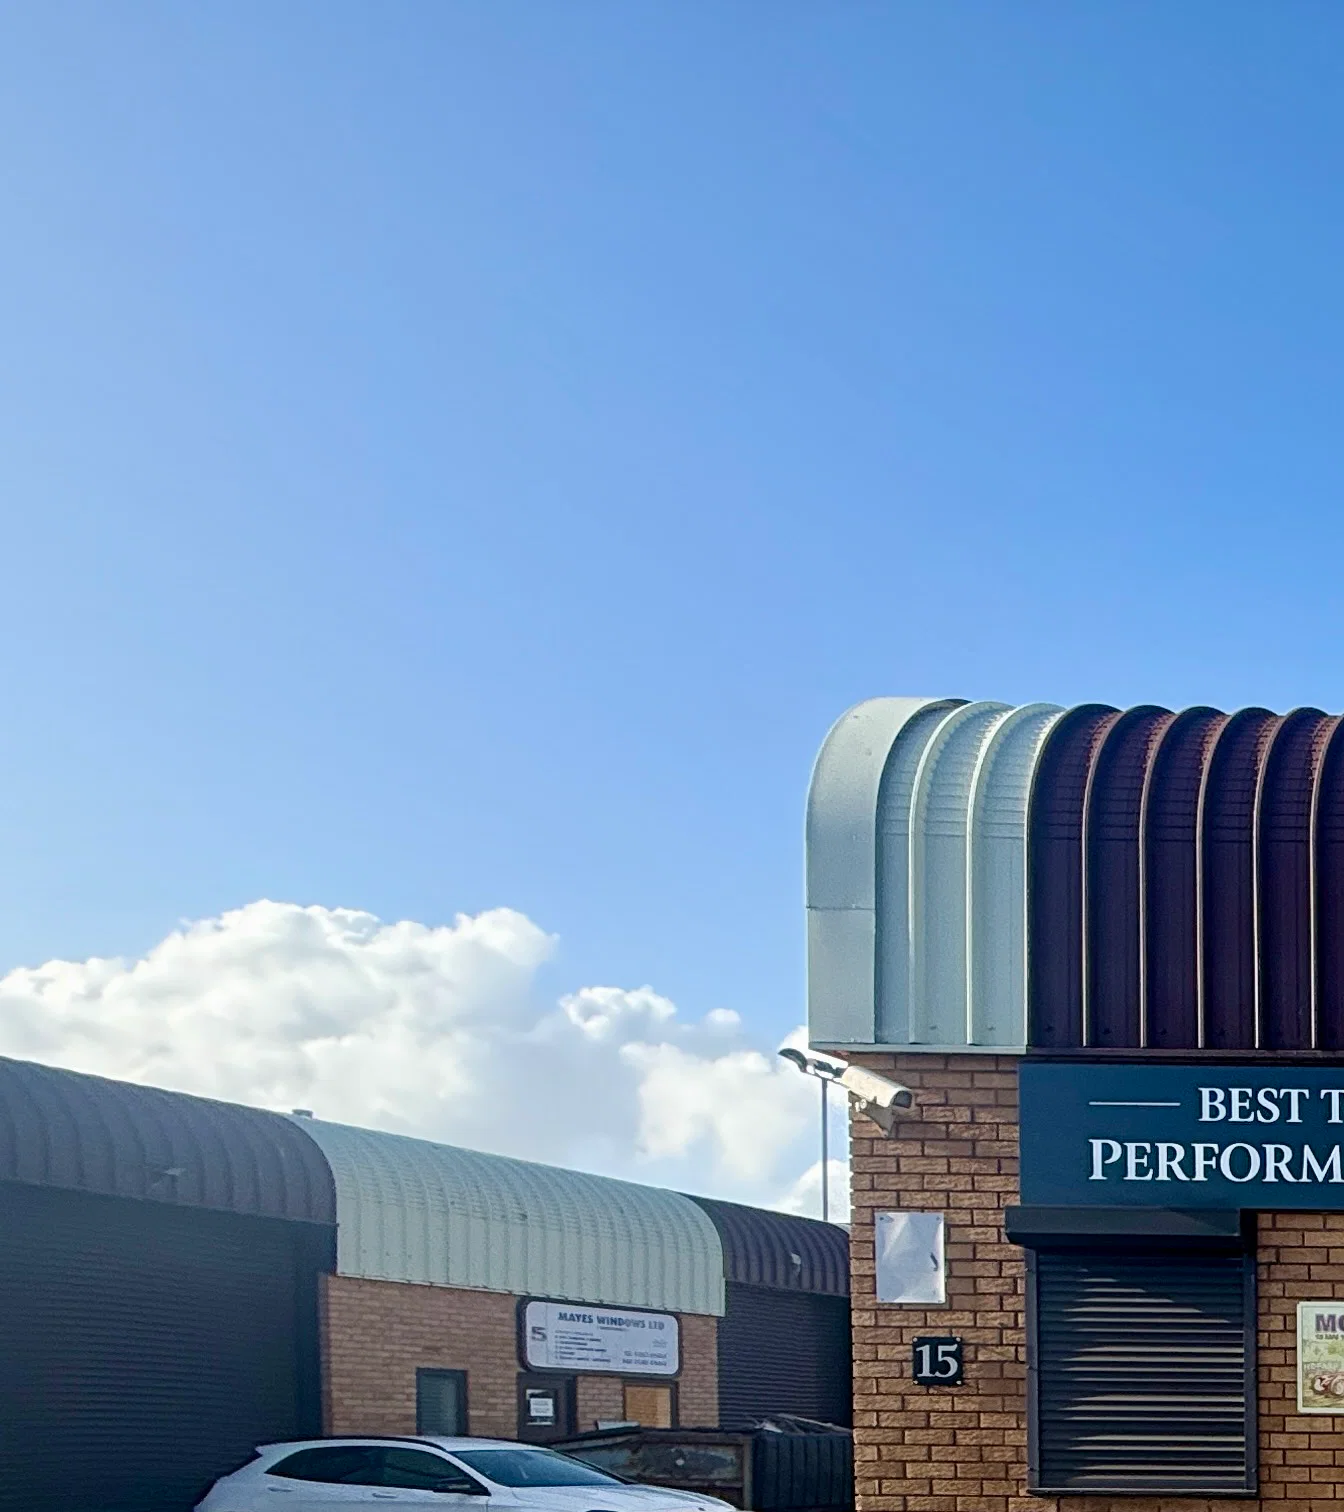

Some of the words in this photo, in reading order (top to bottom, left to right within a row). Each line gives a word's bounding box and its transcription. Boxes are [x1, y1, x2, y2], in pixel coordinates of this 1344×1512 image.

[1198, 1087, 1310, 1123] BEST
[531, 1326, 548, 1342] 5
[558, 1312, 594, 1324] MAYES
[596, 1315, 646, 1329] WINDOWS
[648, 1320, 665, 1330] LTD
[915, 1344, 958, 1378] 15
